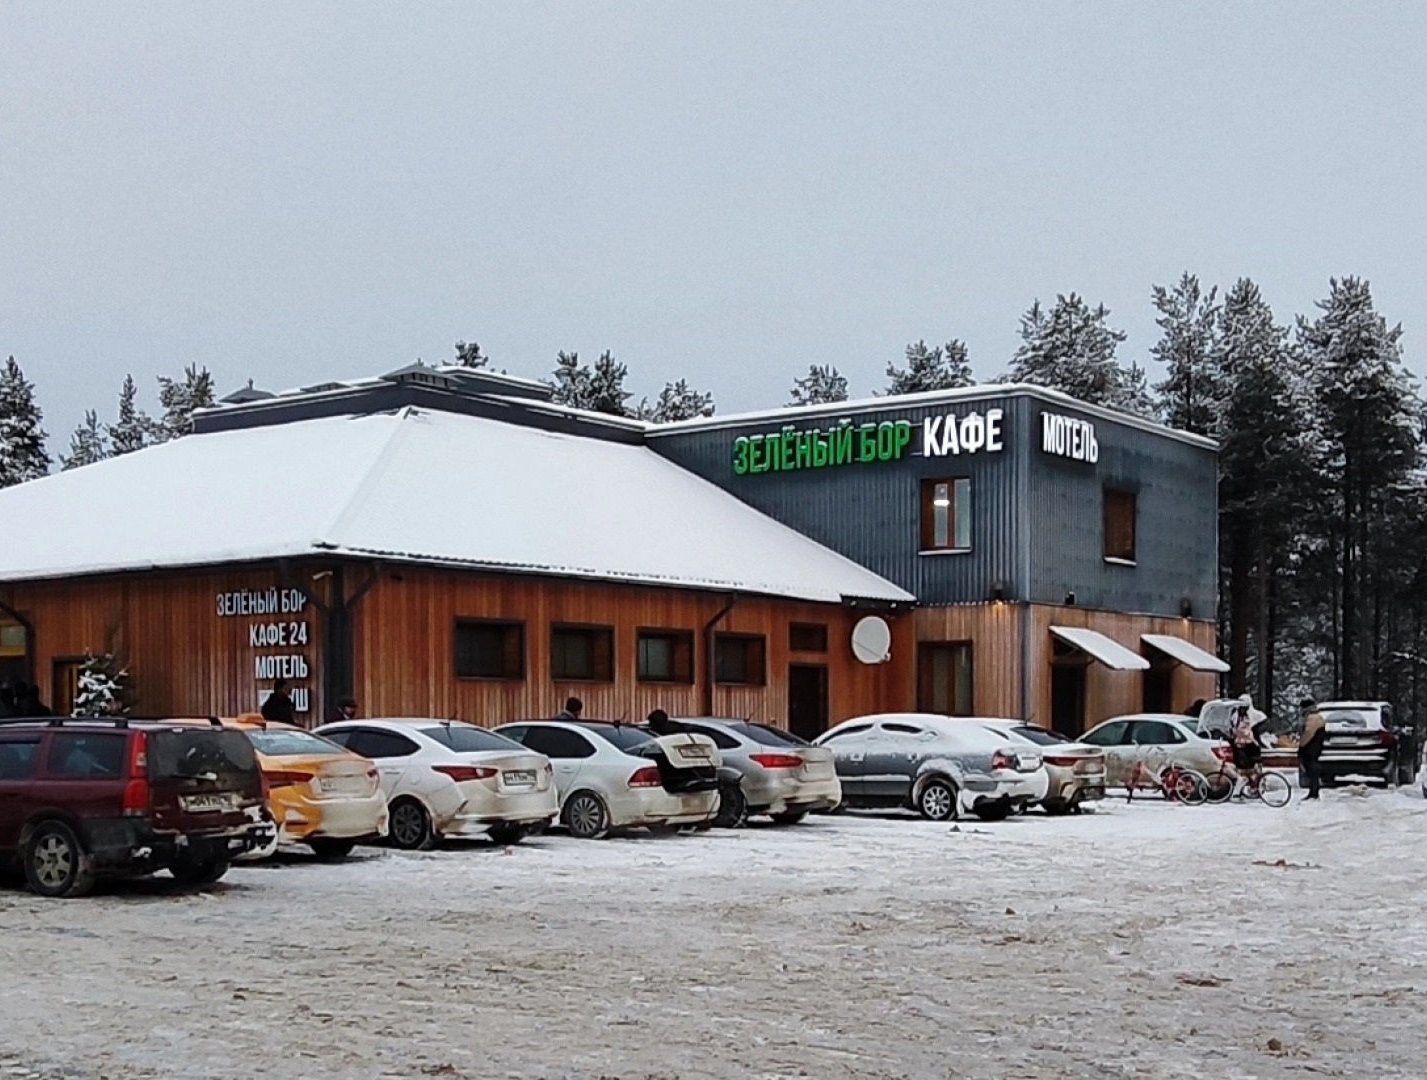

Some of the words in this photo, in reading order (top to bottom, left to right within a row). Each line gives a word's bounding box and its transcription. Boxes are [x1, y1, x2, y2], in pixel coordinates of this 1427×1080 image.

[734, 418, 855, 475] ЗЕЛЁНЫЙ
[860, 420, 912, 462] БОР
[924, 409, 1003, 457] КАФЕ
[1041, 411, 1099, 463] МОТЕЛЬ
[216, 586, 279, 616] ЗЕЛЁНЫЙ
[281, 589, 307, 613] БОР
[249, 623, 287, 647] КАФЕ
[289, 621, 307, 645] 24
[255, 655, 308, 679] МОТЕЛЬ
